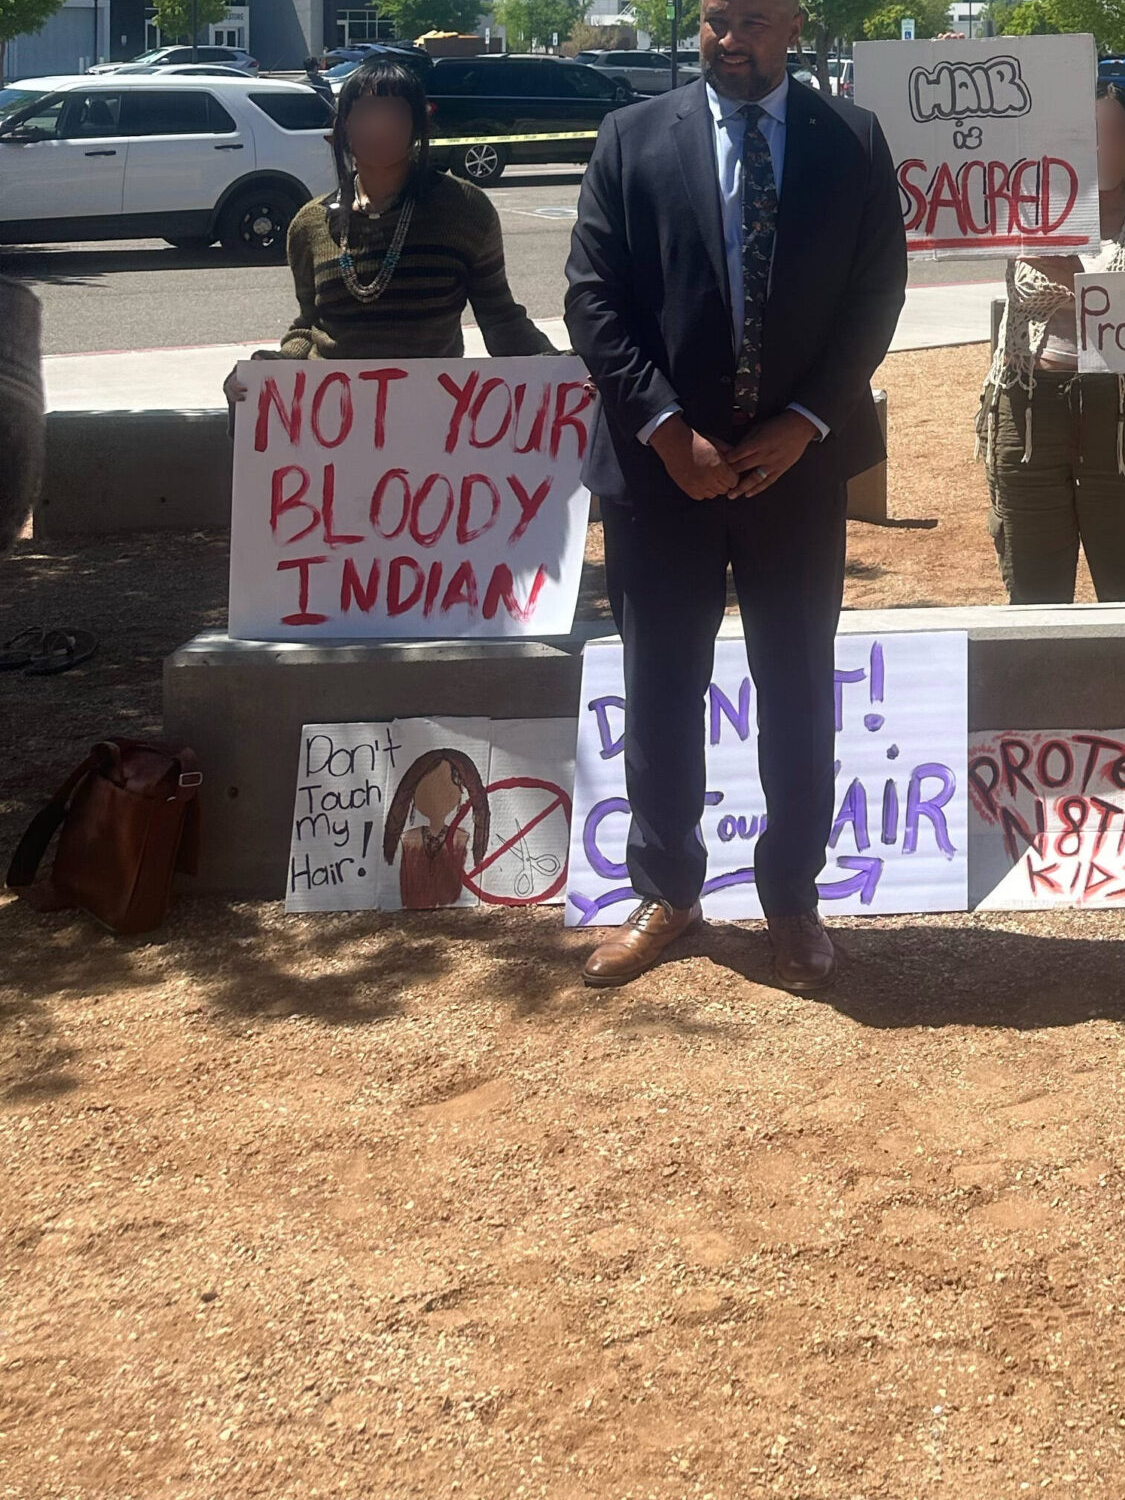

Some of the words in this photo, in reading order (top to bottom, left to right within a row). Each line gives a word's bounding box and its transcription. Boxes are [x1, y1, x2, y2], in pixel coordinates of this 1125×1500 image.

[910, 56, 1031, 122] HAIR
[953, 119, 983, 149] is
[896, 155, 1079, 237] SACRED
[254, 368, 408, 452] NOT
[438, 369, 593, 460] YOUR
[269, 461, 554, 549] BLOODY
[277, 556, 548, 626] INDIAN
[306, 728, 402, 777] Don't
[298, 779, 382, 813] Touch
[290, 821, 373, 892] Hair!
